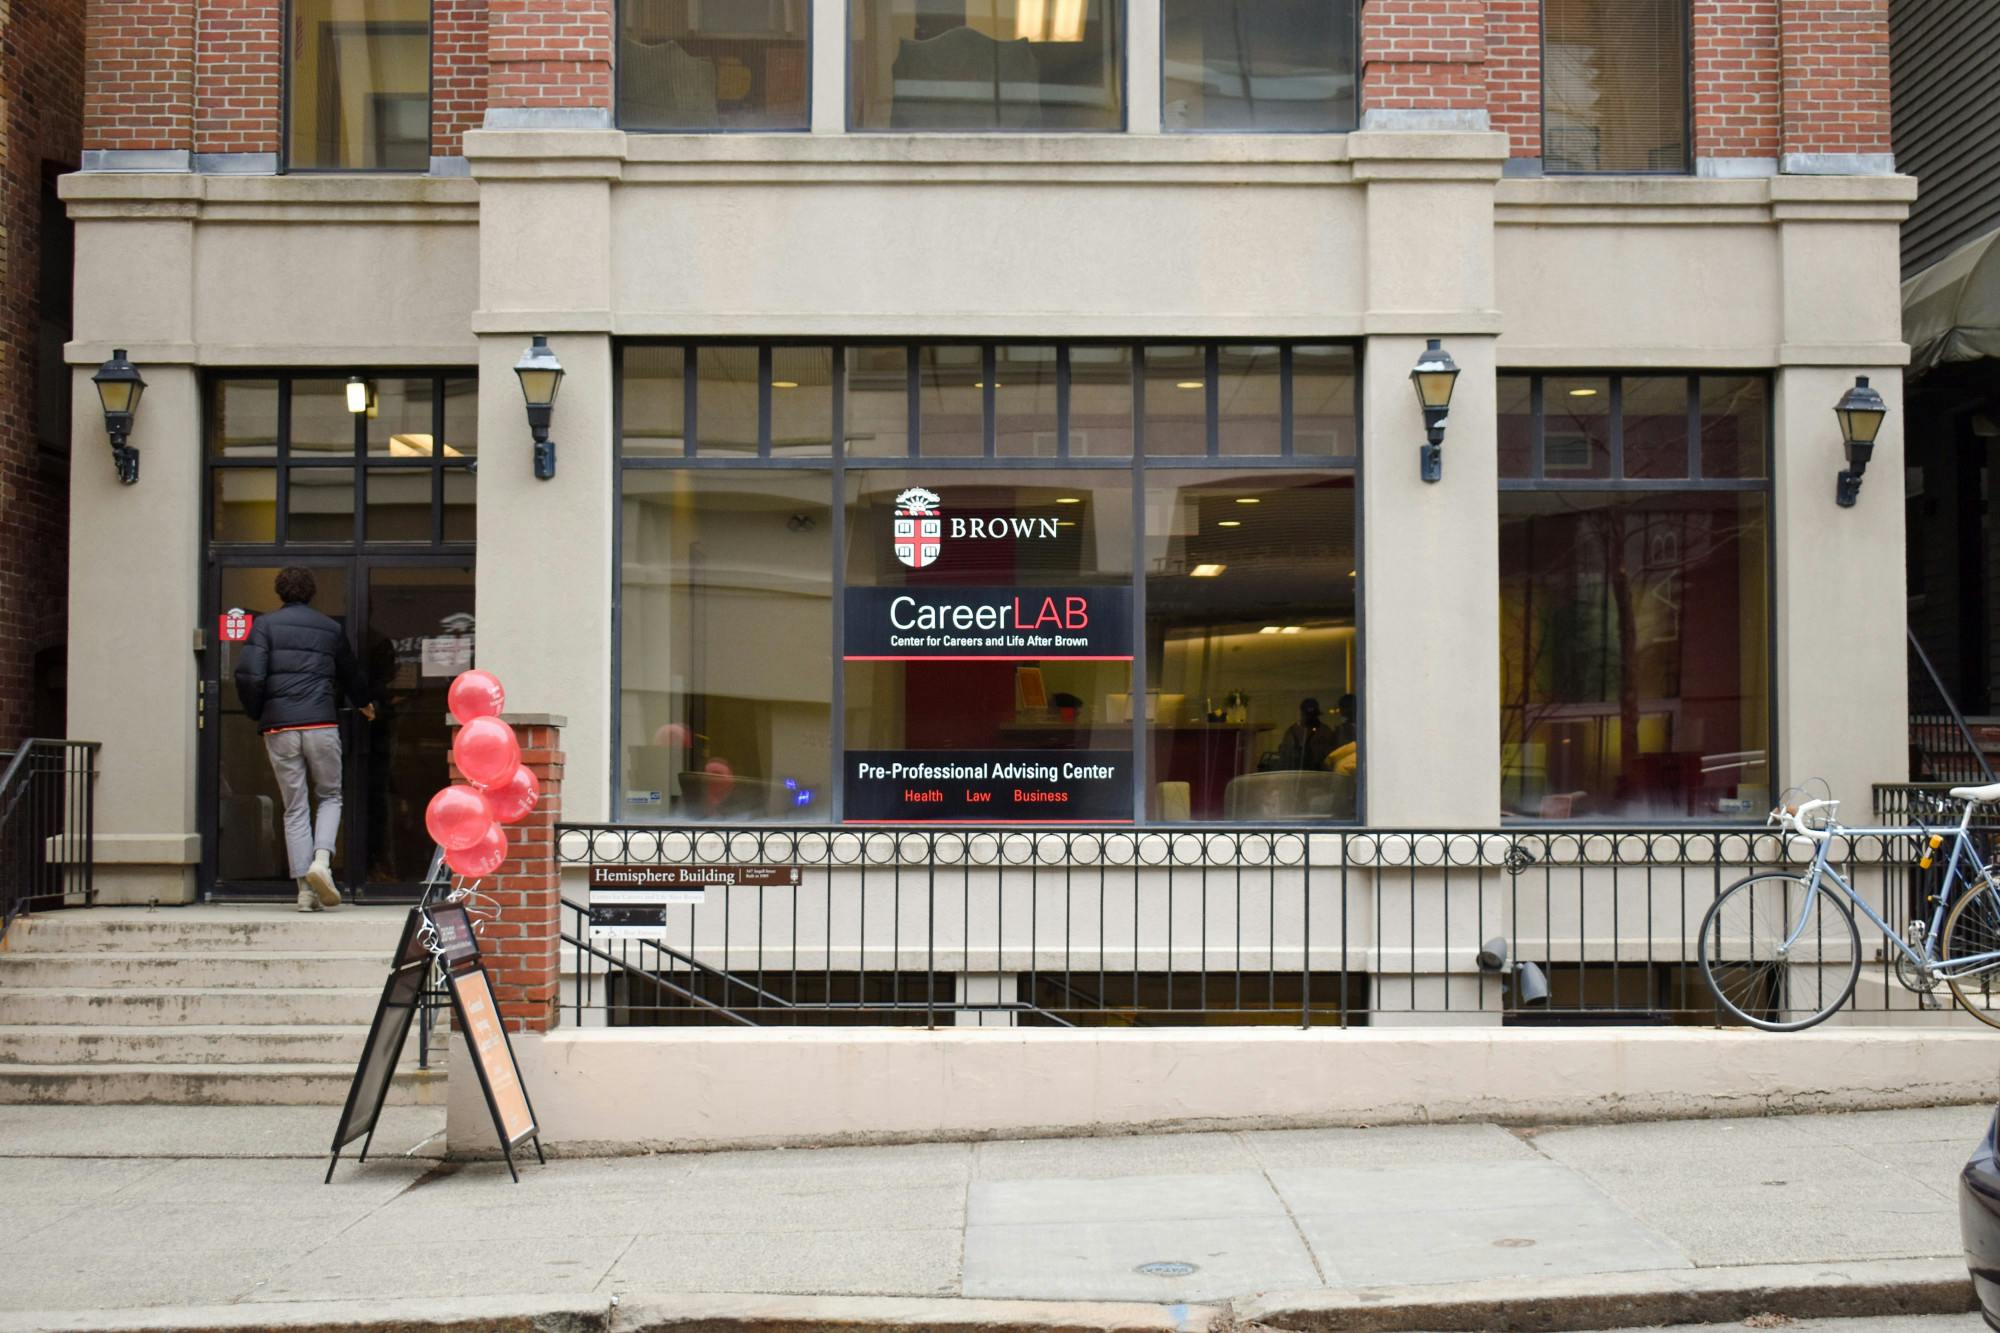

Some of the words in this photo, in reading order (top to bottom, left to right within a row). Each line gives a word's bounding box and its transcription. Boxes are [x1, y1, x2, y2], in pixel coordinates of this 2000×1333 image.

[950, 517, 1059, 539] BROWN
[890, 595, 1089, 630] CareerLAB
[890, 635, 926, 647] Center
[926, 635, 942, 647] for
[943, 635, 984, 647] Careers
[985, 635, 1005, 647] and
[1006, 635, 1025, 647] Life
[1027, 635, 1053, 647] After
[1054, 635, 1089, 647] Brown
[858, 762, 988, 780] Pre-Professional
[991, 762, 1059, 783] Advising
[1062, 762, 1115, 780] Center
[904, 789, 944, 802] Health
[966, 789, 992, 802] Law
[1014, 789, 1069, 802] Business
[595, 868, 676, 886] Hemisphere
[679, 868, 736, 886] Building
